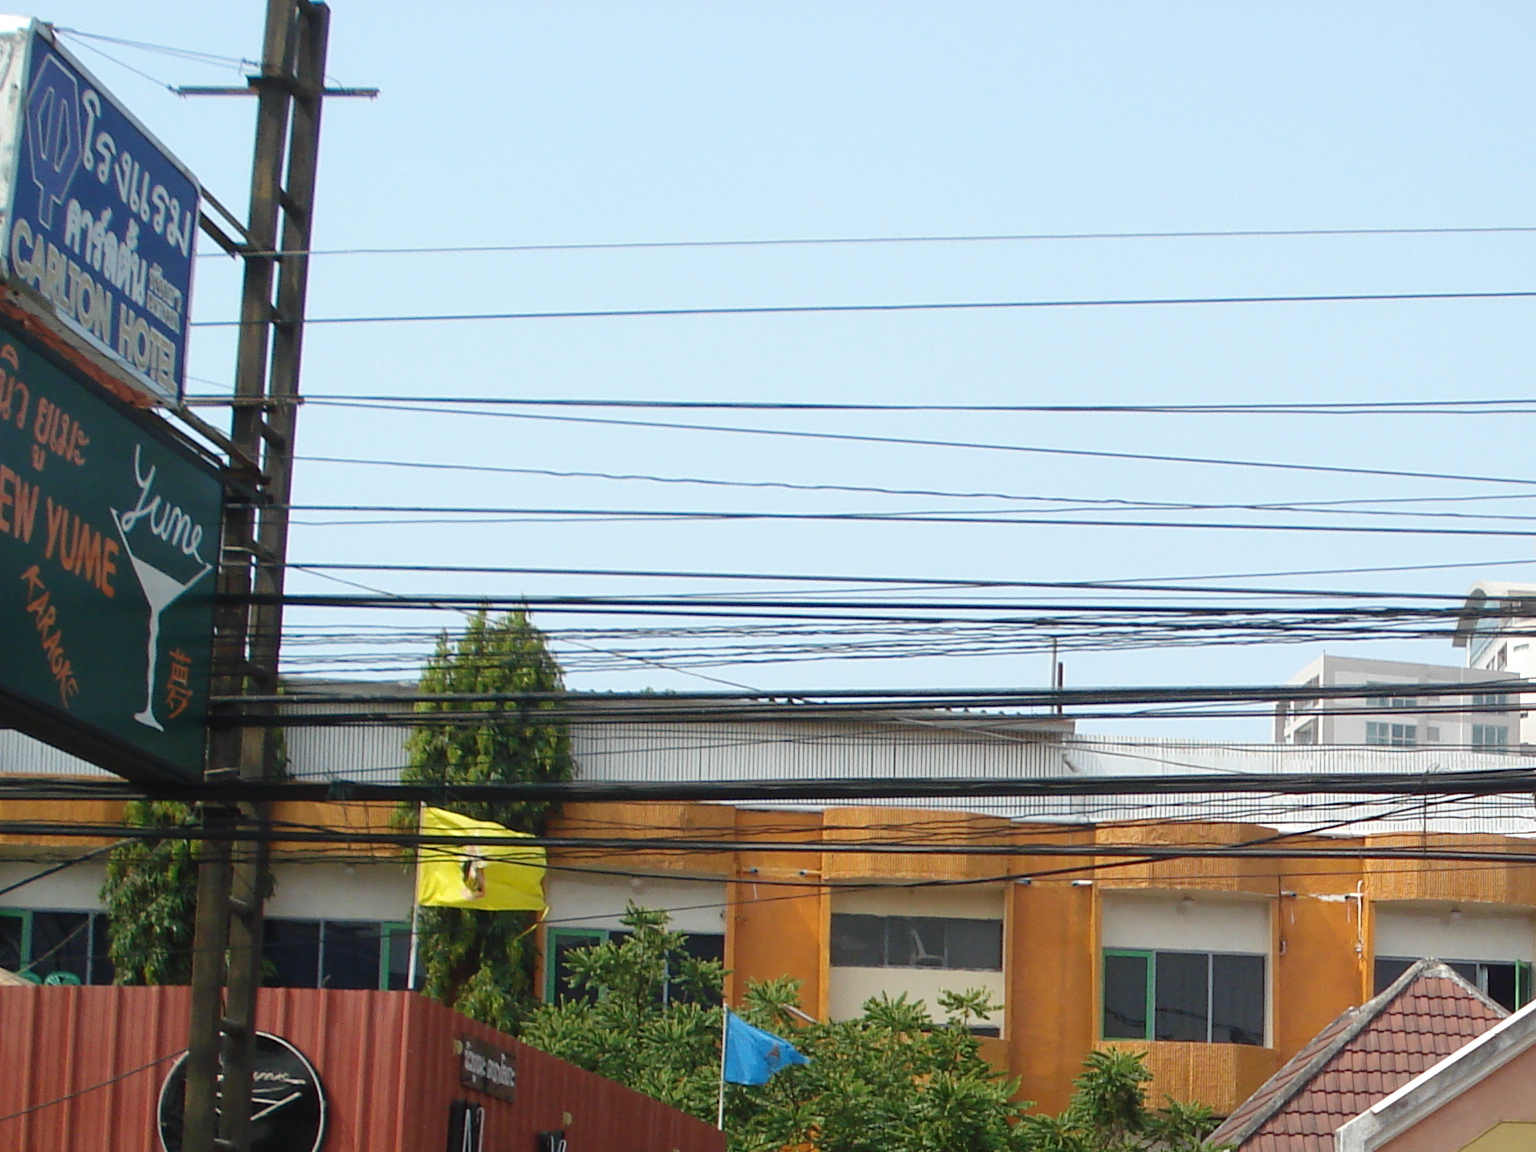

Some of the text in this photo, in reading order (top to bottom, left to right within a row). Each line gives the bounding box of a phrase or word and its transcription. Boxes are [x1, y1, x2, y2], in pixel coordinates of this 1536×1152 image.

[82, 89, 193, 258] โรงแรม
[12, 219, 178, 393] CARLTON HOTEL
[45, 496, 120, 598] YUME
[20, 565, 80, 707] KARAOKE
